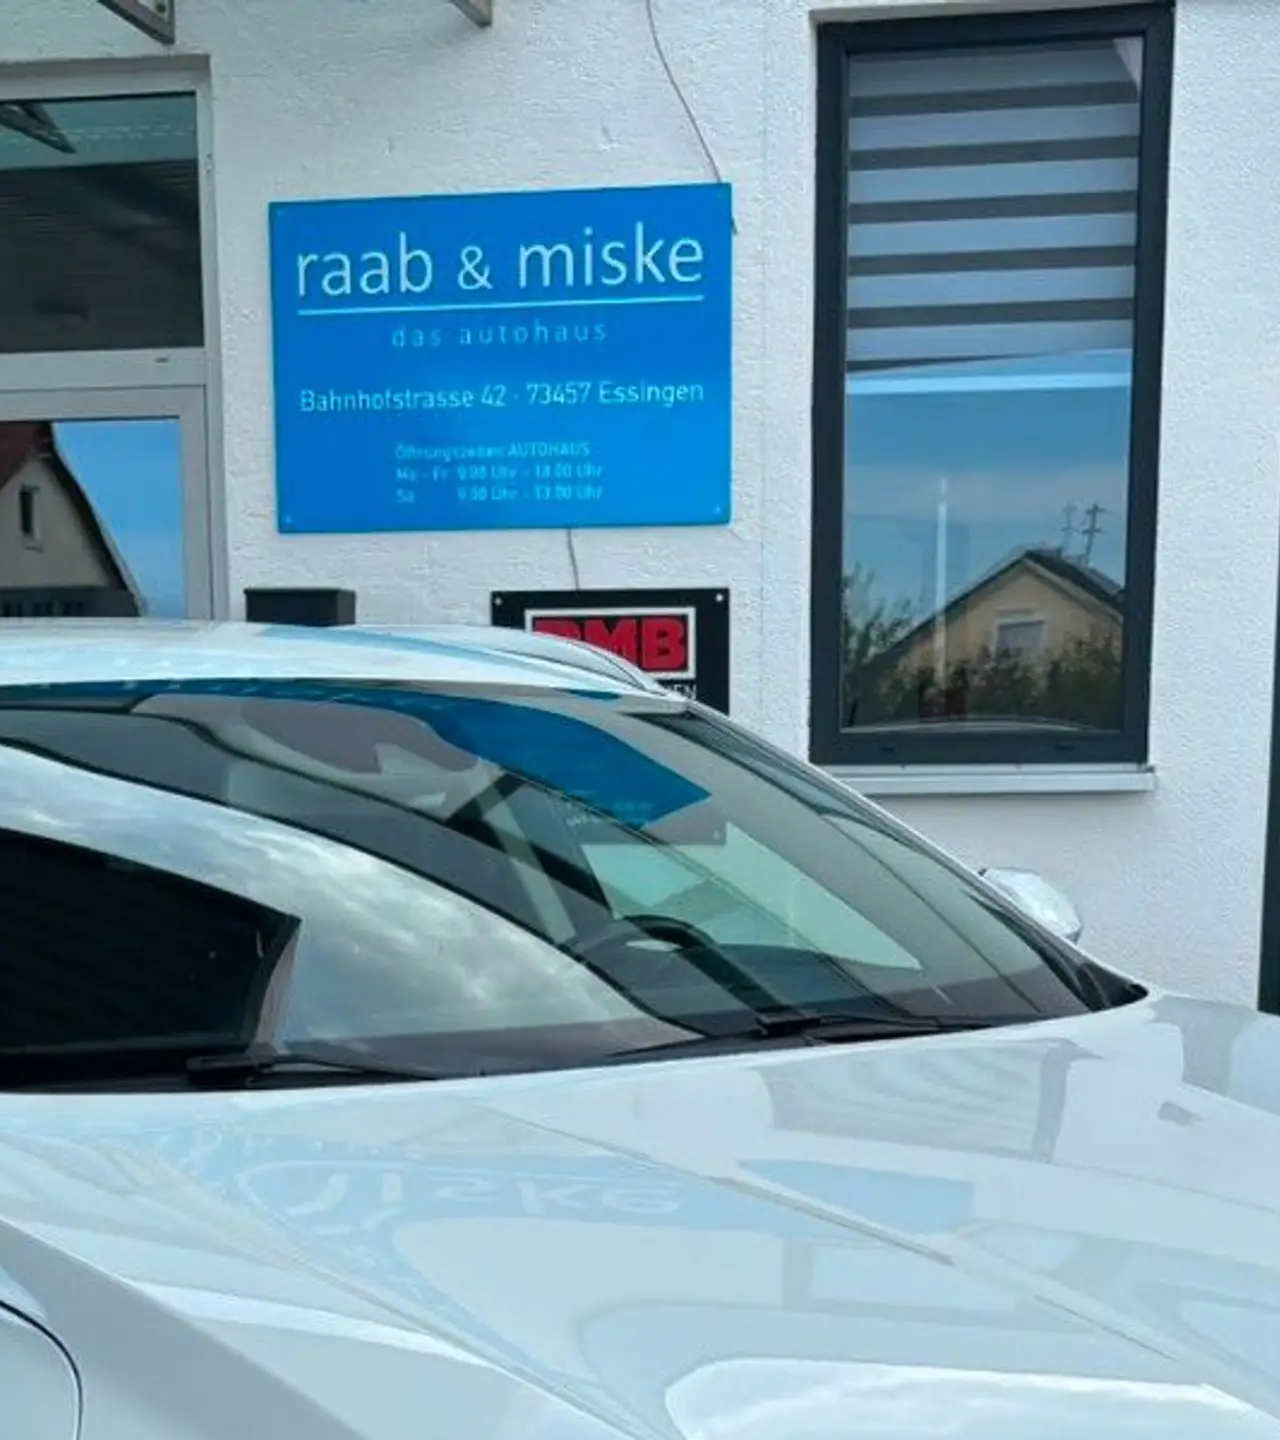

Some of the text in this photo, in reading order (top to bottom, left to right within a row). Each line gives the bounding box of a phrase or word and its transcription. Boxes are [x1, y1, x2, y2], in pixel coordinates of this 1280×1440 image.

[297, 221, 704, 297] raab & miske
[392, 320, 608, 348] das autohaus
[300, 389, 474, 412] Bahnhofstrasse
[481, 384, 507, 407] 42
[526, 382, 591, 405] 73457
[599, 380, 704, 409] Essingen
